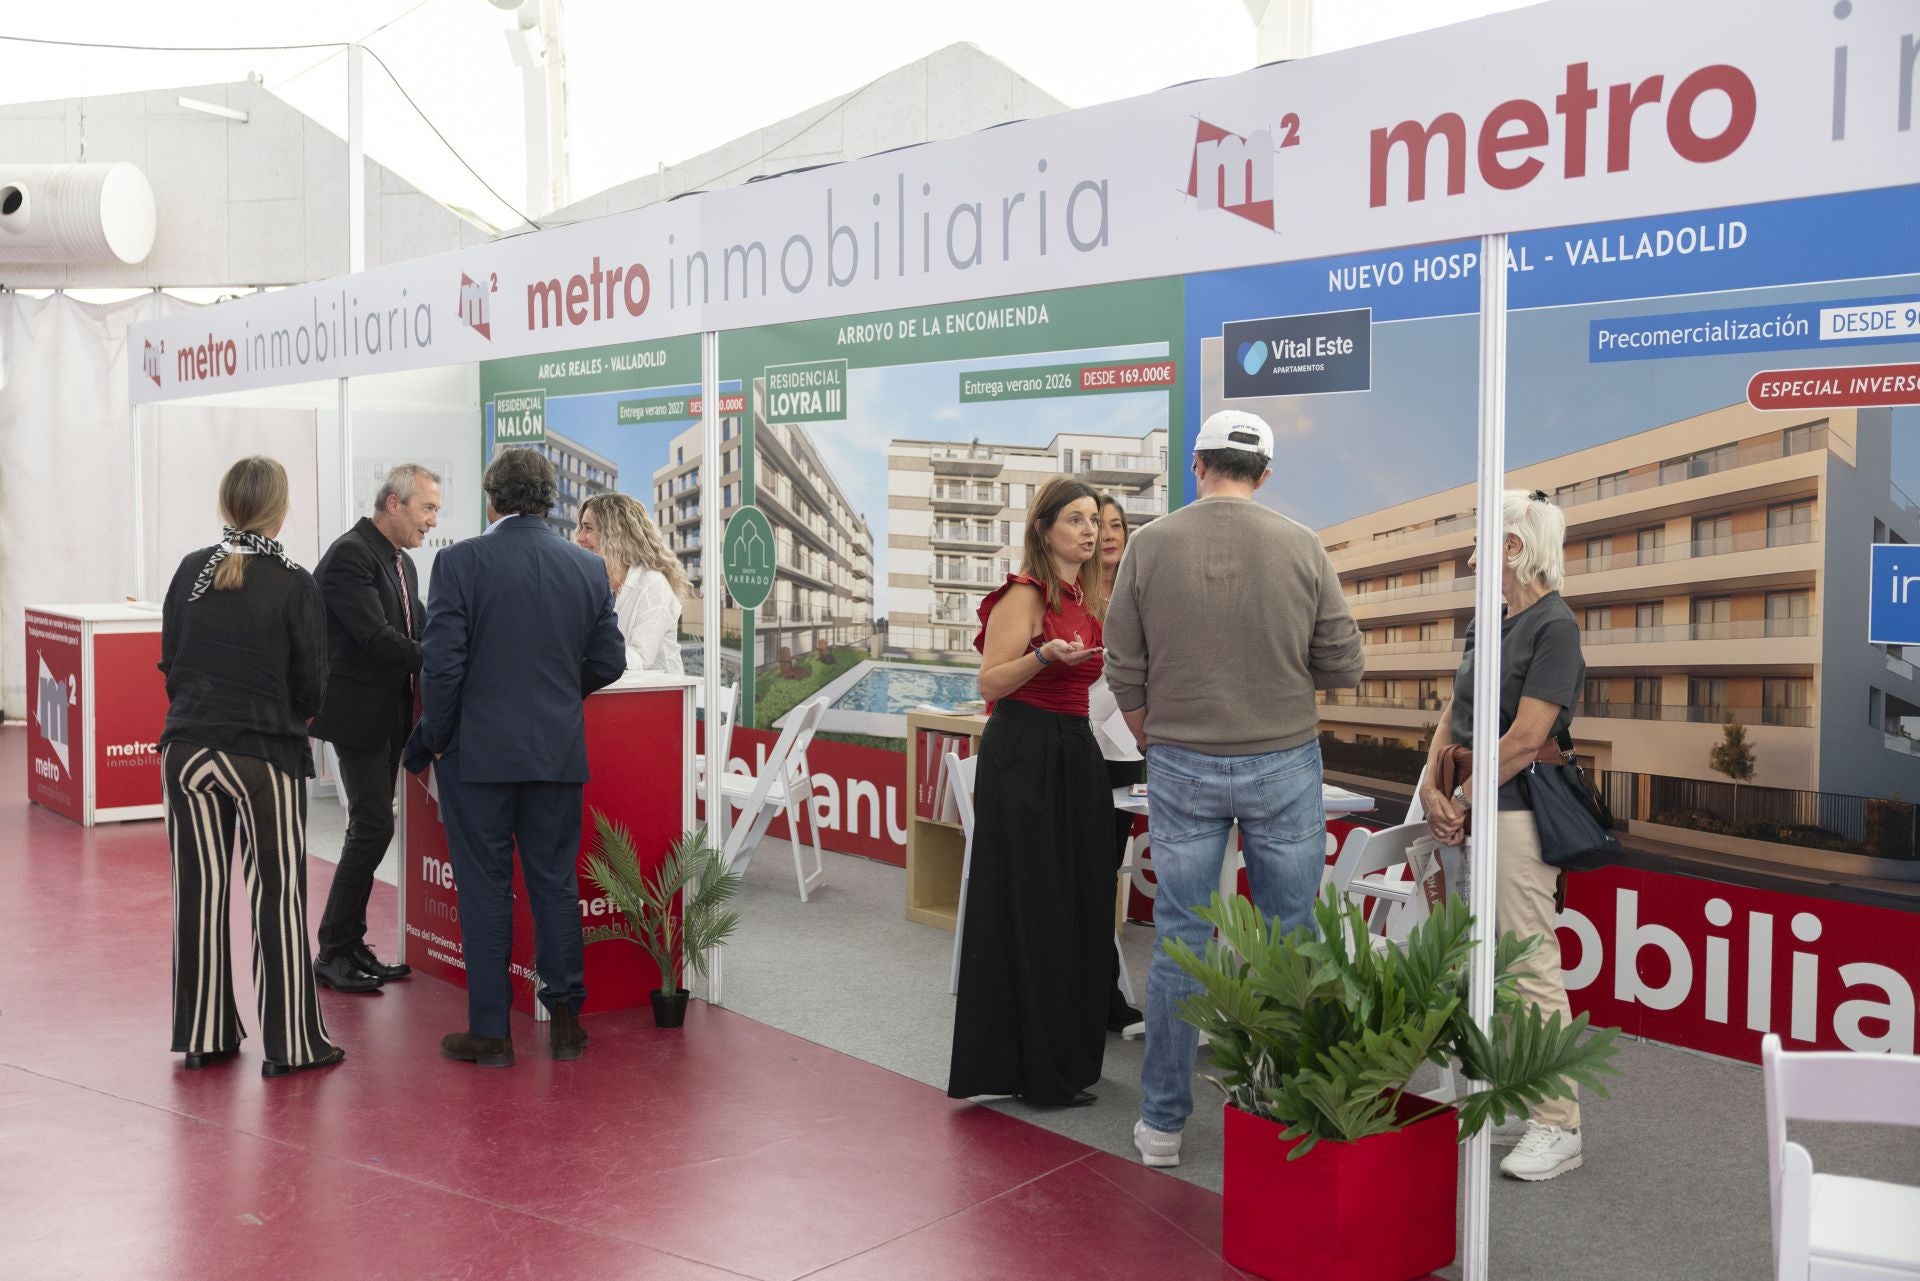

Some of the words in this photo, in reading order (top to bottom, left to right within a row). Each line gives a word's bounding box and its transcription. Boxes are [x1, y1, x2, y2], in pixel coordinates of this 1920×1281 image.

[1370, 61, 1757, 209] metro
[528, 256, 650, 331] metro
[669, 158, 1110, 310] inmobiliaria
[1328, 261, 1404, 292] NUEVO
[1414, 246, 1535, 283] HOSPAL
[1565, 221, 1748, 266] VALLADOLID
[177, 333, 237, 382] metro
[246, 288, 432, 372] inmobiliaria
[837, 322, 893, 345] ARROYO
[898, 319, 917, 339] DE
[922, 316, 941, 336] LA
[946, 304, 1049, 334] ENCOMIENDA
[1598, 313, 1809, 350] Precomercialización
[1833, 310, 1897, 333] DESDE
[1271, 338, 1311, 360] Vital
[1316, 336, 1353, 356] Este
[538, 362, 566, 380] ARCAS
[569, 358, 602, 376] REALES
[611, 350, 667, 371] VALLADOLID
[1273, 363, 1325, 374] APARTAMENTOS
[769, 369, 841, 389] RESIDENCIAL
[965, 379, 1004, 397] Entrega
[1006, 377, 1042, 392] verano
[1045, 373, 1072, 390] 2026
[1083, 370, 1116, 386] DESDE
[1119, 366, 1171, 384] 169.000€
[1760, 379, 1842, 398] ESPECIAL
[497, 396, 541, 413] RESIDENCIAL
[620, 406, 644, 420] Entrega
[645, 405, 667, 416] verano
[668, 401, 684, 414] 2027
[690, 401, 702, 413] DES
[770, 391, 822, 416] LOYRA
[826, 389, 841, 413] III
[497, 411, 543, 437] NALÓN
[729, 575, 769, 585] PARRADO
[35, 757, 60, 782] metro
[406, 923, 420, 938] Plaza
[422, 929, 431, 941] del
[431, 933, 458, 953] Poniente,
[427, 948, 466, 970] www.metroin
